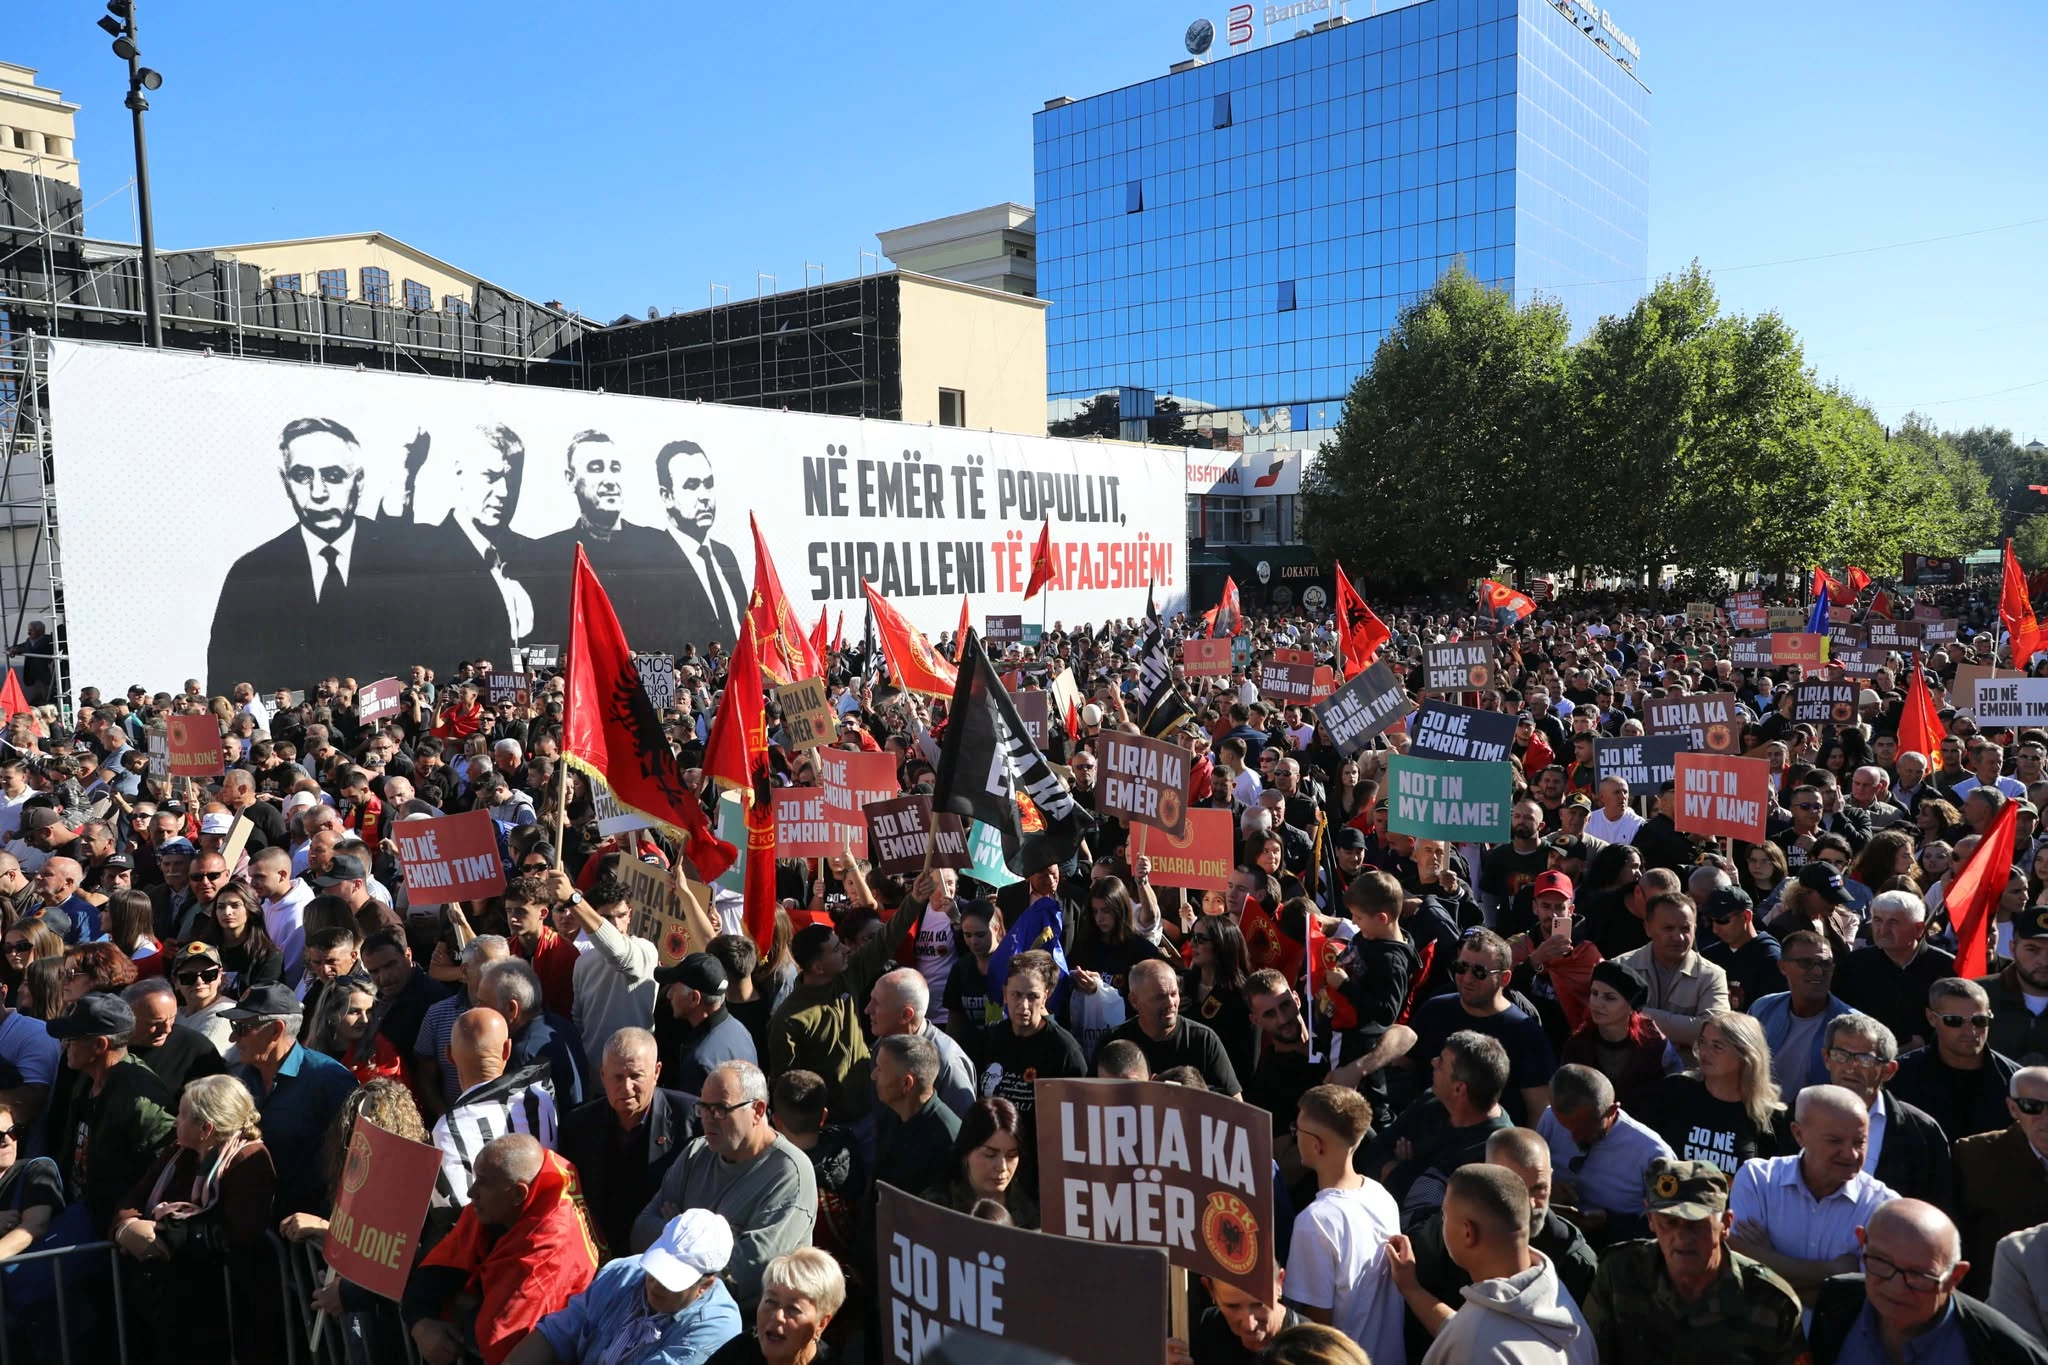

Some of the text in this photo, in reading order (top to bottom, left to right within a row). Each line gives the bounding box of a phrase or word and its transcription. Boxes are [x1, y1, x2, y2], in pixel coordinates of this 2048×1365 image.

[803, 444, 1126, 527] NË EMËR TË POPULLIT,
[808, 530, 1173, 600] SHPALLENI TË AFAJSHËM!
[1281, 566, 1320, 578] LOKANTA
[1871, 623, 1897, 635] JO NË
[1926, 622, 1945, 632] JO NË
[1926, 631, 1945, 640] EMRIN
[1734, 641, 1757, 653] JO NË
[1871, 635, 1919, 647] EMRIN TIM!
[639, 657, 673, 673] MOS
[1428, 646, 1487, 668] LIRIA KA
[1733, 652, 1773, 663] EMRIN TIM
[1838, 651, 1863, 663] JO NË
[489, 675, 527, 689] LIRIA KA
[642, 673, 668, 685] MA
[1263, 667, 1290, 681] JO NË
[1430, 666, 1468, 688] EMËR
[801, 686, 822, 711] KA
[1262, 679, 1310, 696] EMRIN TIM!
[1312, 682, 1331, 696] AME!
[1797, 685, 1853, 702] LIRIA KA
[1979, 684, 2018, 702] JO NË
[381, 696, 398, 711] TIM!
[1324, 688, 1364, 729] JO NË
[1331, 686, 1404, 746] EMRIN TIM!
[1651, 701, 1729, 727] LIRIA KA
[1795, 701, 1831, 720] EMËR
[1980, 702, 2023, 717] EMRIN
[1421, 710, 1471, 736] JO NË
[193, 750, 219, 766] JONË
[1416, 729, 1506, 762] EMRIN TIM!
[1600, 744, 1643, 766] JO NË
[822, 759, 848, 786] JO NË
[1107, 741, 1183, 791] LIRIA KA
[1600, 765, 1675, 784] EMRIN TIM
[1399, 770, 1463, 800] NOT IN
[1684, 767, 1738, 797] NOT IN
[777, 796, 825, 821] JO NË
[823, 781, 852, 811] EMRIN
[1105, 777, 1158, 819] EMËR
[873, 804, 923, 838] JO NË
[1399, 797, 1500, 827] MY NAME!
[1684, 794, 1760, 827] MY NAME!
[399, 829, 441, 862] JO NË
[778, 823, 830, 843] EMRIN
[878, 832, 934, 861] EMRIN
[973, 842, 1001, 869] MY
[404, 853, 497, 889] EMRIN TIM!
[1197, 858, 1228, 878] JONË
[1060, 1101, 1257, 1197] LIRIA KA
[1687, 1126, 1737, 1153] JO NË
[1684, 1144, 1738, 1175] EMRIN
[1063, 1167, 1197, 1253] EMËR
[1211, 1194, 1255, 1231] UÇK
[353, 1223, 407, 1270] JONË
[889, 1232, 1006, 1337] JO NË
